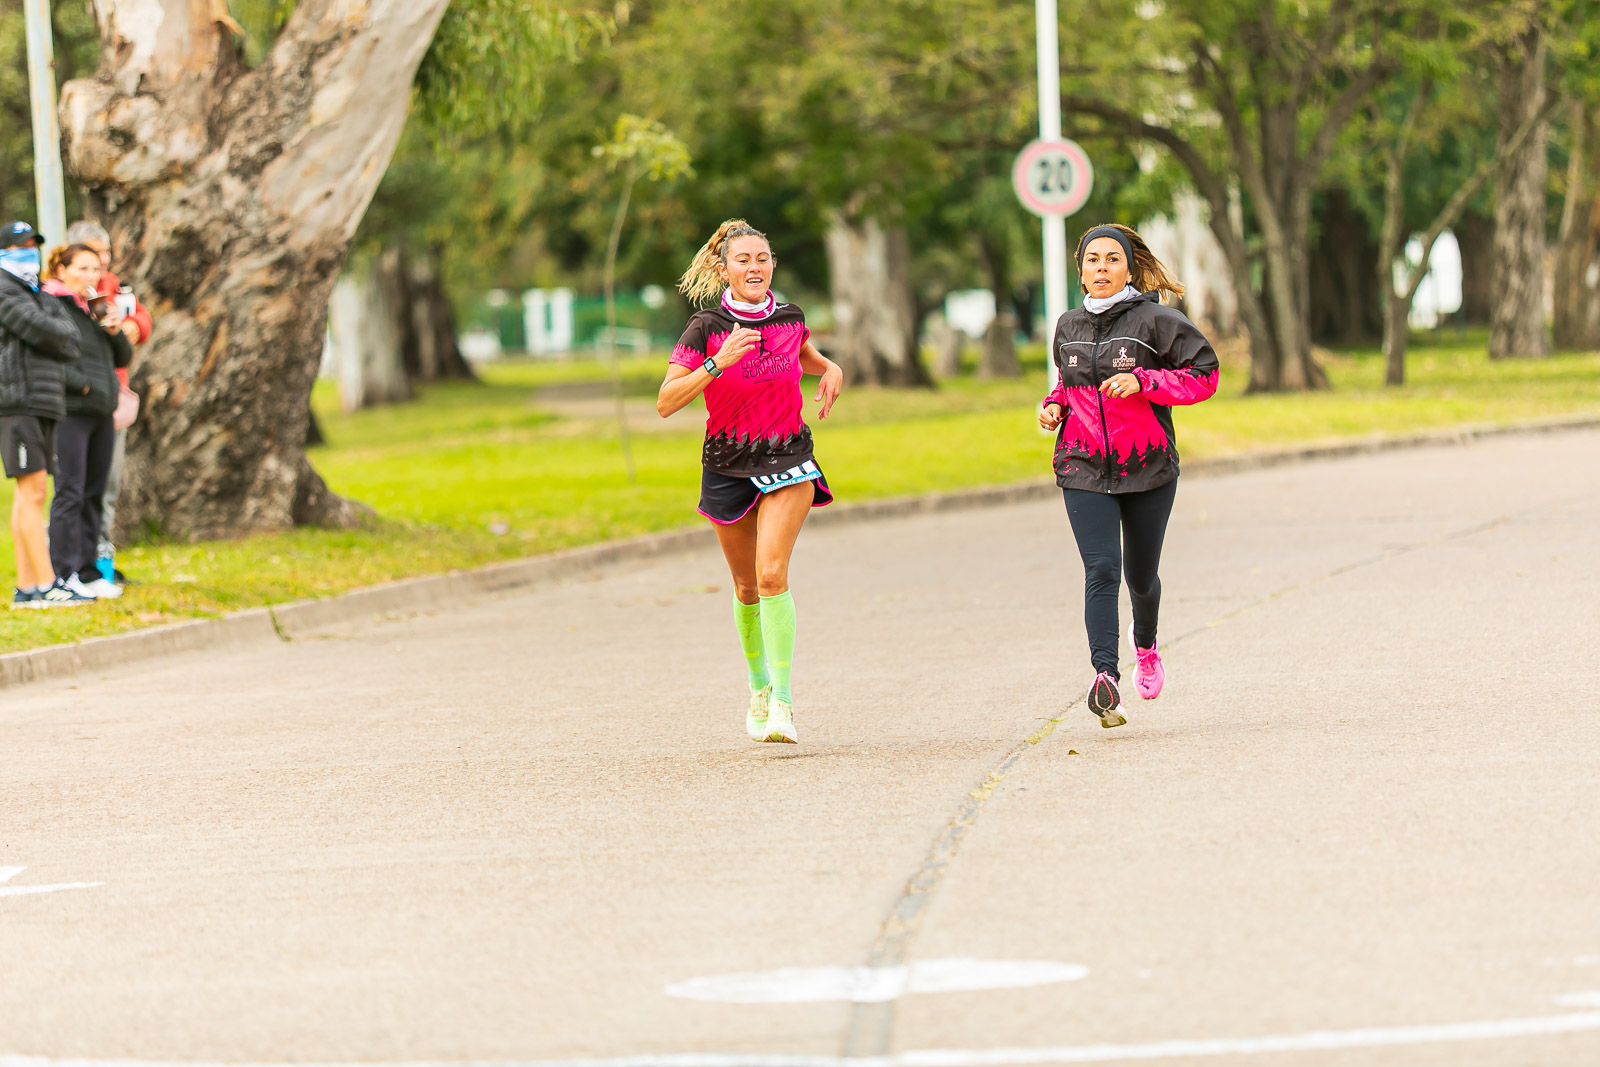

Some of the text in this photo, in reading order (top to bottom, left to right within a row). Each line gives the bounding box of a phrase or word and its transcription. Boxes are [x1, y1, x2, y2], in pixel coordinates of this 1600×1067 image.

[1036, 158, 1072, 193] 20
[740, 353, 791, 370] WOMAN
[741, 362, 793, 380] RUNNING
